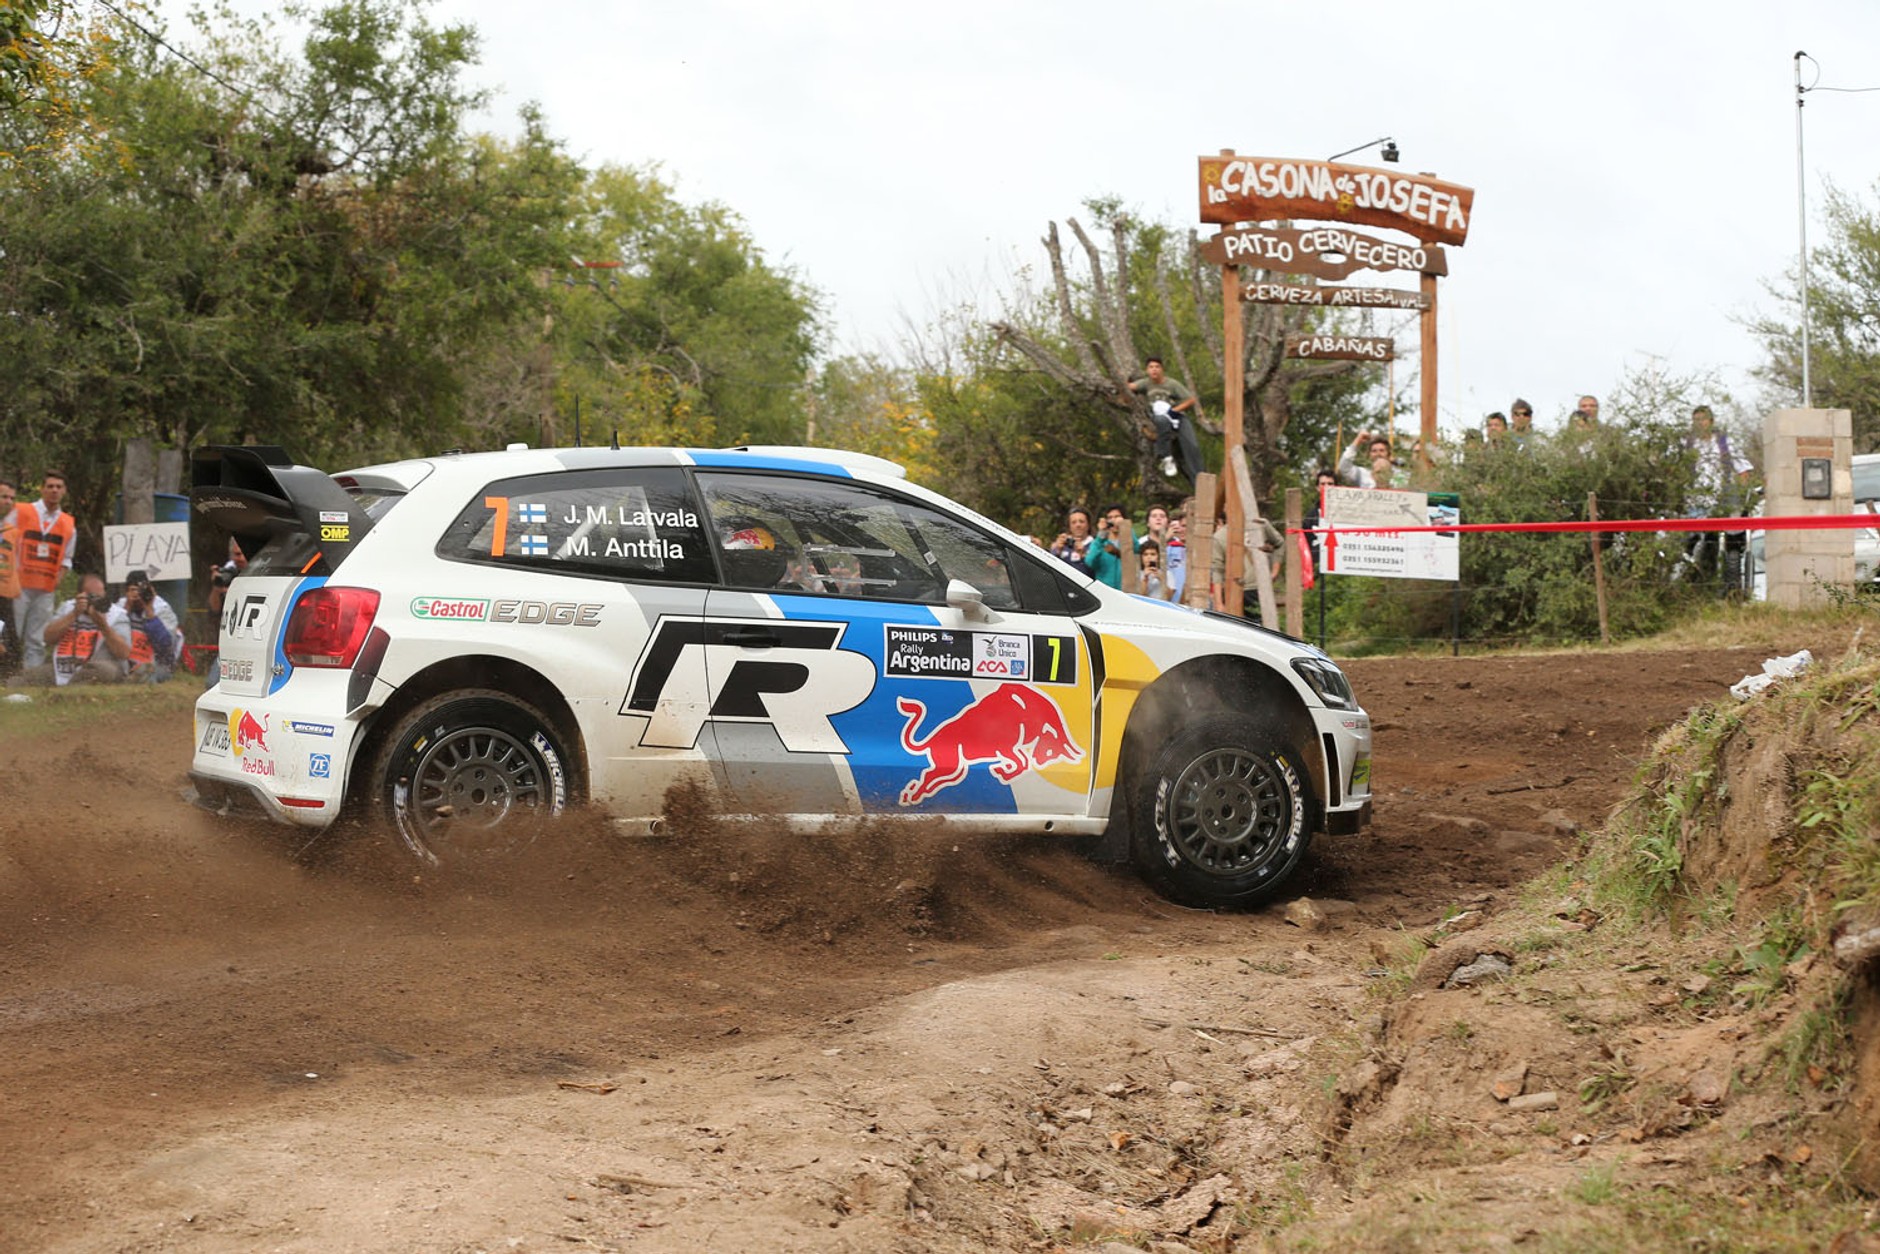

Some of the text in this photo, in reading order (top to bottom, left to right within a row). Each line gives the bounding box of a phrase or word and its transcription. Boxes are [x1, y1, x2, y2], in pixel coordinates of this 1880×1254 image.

[1208, 161, 1466, 229] la CASONA de JOSEFA
[1224, 230, 1427, 269] PATIO CERVECERO
[1245, 284, 1322, 304] CERVEZA
[1298, 337, 1387, 358] CABAÑAS
[485, 496, 509, 557] 7
[564, 505, 699, 528] J. M. Latvala
[321, 527, 349, 541] OMP
[108, 531, 191, 567] PLAYA
[567, 537, 685, 560] M. Anttila
[430, 600, 605, 627] Castrol EDGE
[891, 631, 937, 643] PHILIPS
[998, 639, 1020, 649] Branca
[901, 643, 924, 656] Rally
[1047, 637, 1061, 681] 7
[890, 651, 970, 673] Argentina
[976, 660, 1008, 673] ACA
[295, 723, 334, 735] MICHELIN
[241, 757, 275, 776] Red Bull
[313, 759, 326, 771] ZF
